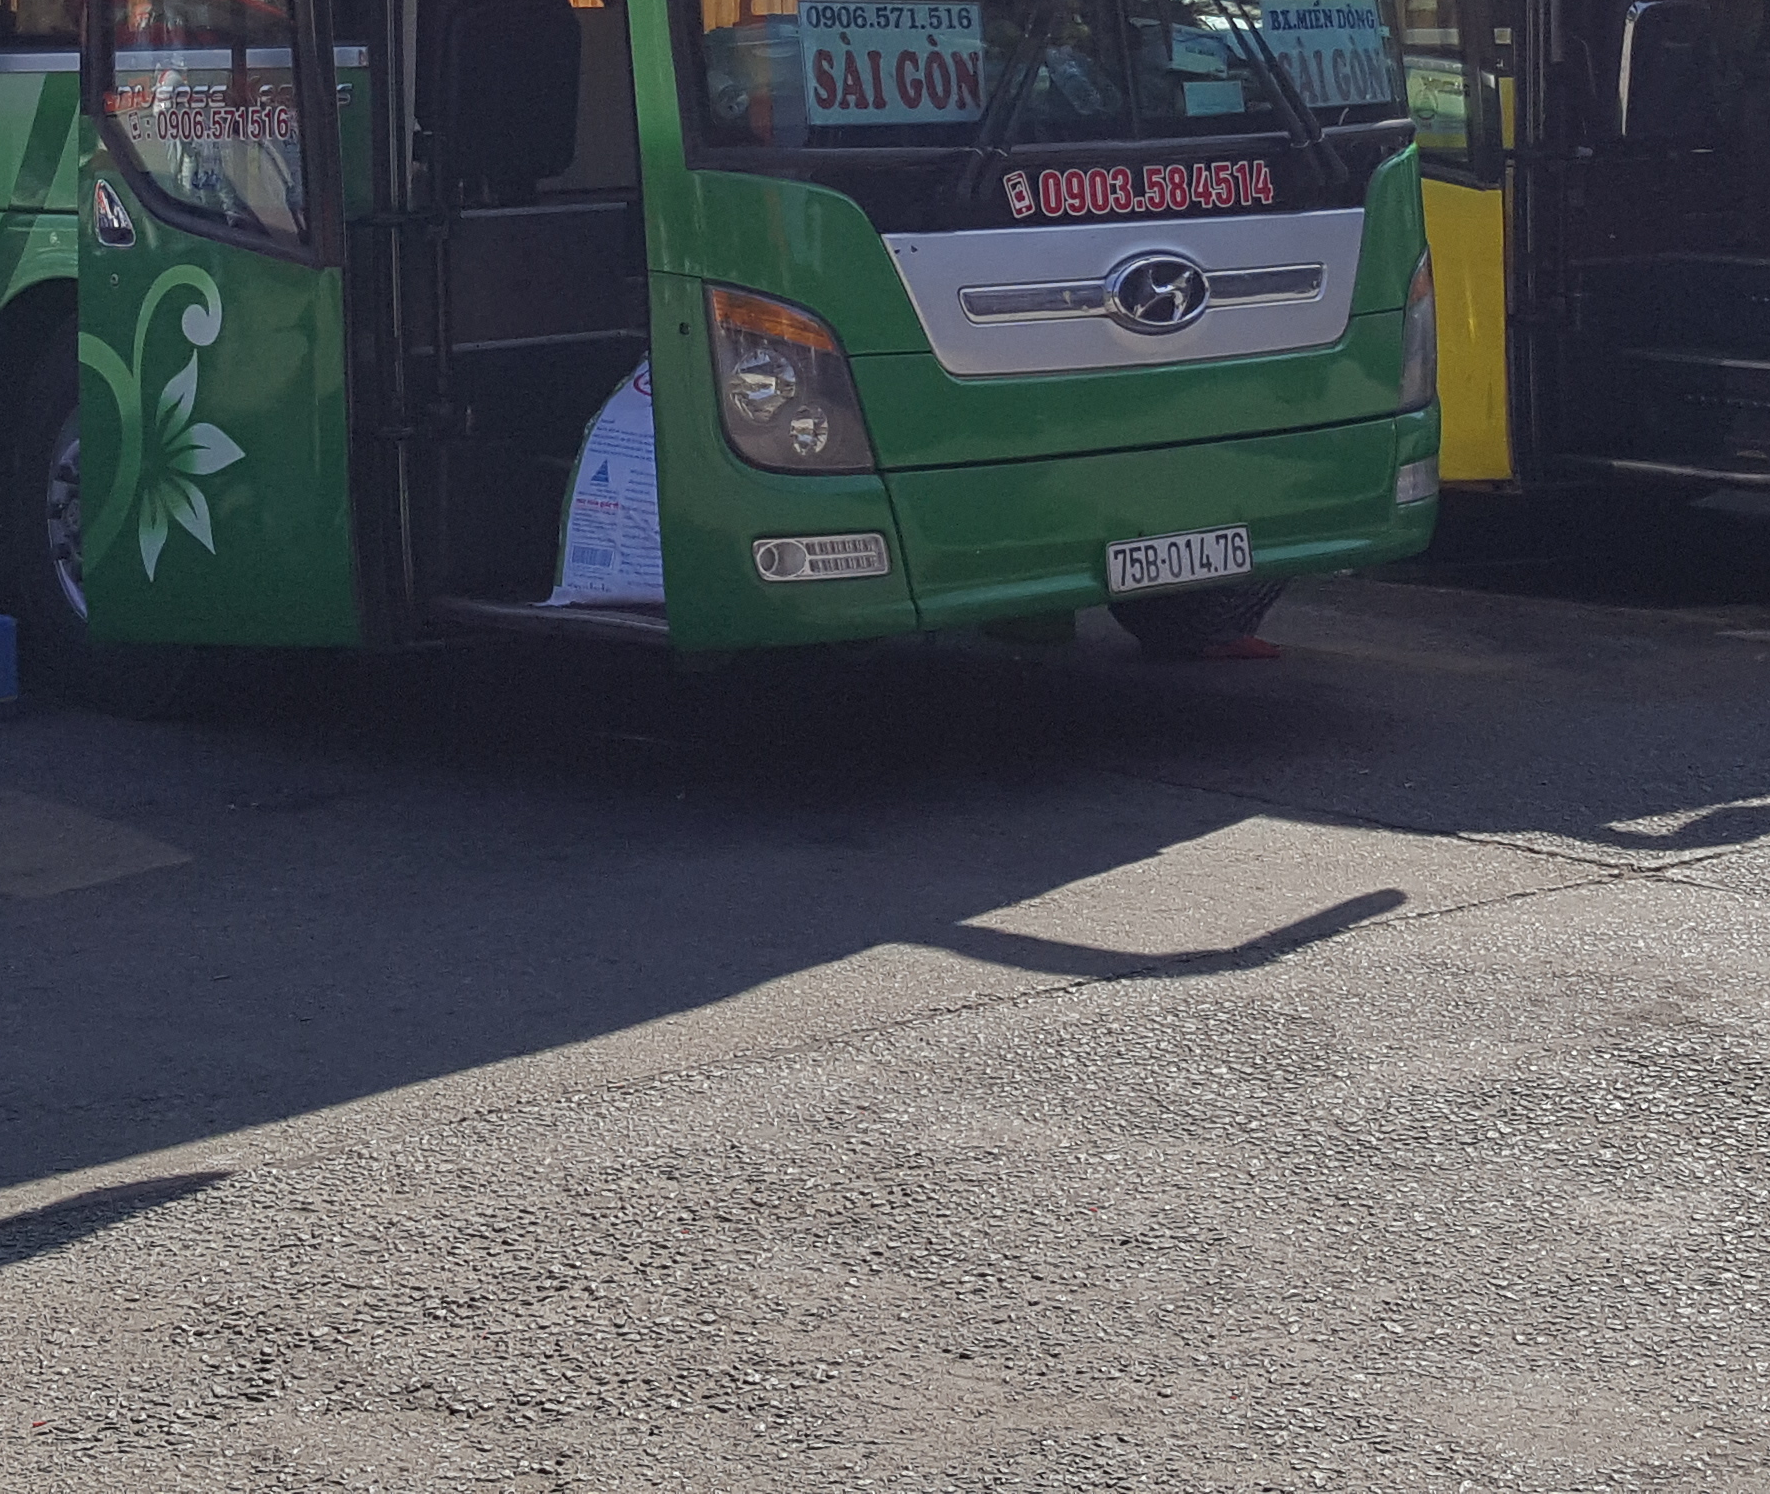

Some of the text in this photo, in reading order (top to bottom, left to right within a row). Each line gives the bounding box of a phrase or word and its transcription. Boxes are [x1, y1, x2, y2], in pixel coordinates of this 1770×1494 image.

[806, 6, 972, 29] 0906.571.516
[812, 31, 980, 110] SÀI GÒN
[156, 106, 291, 141] 0906.571516
[1038, 160, 1273, 217] 0903.584514
[1113, 532, 1246, 587] 75B-014.76
